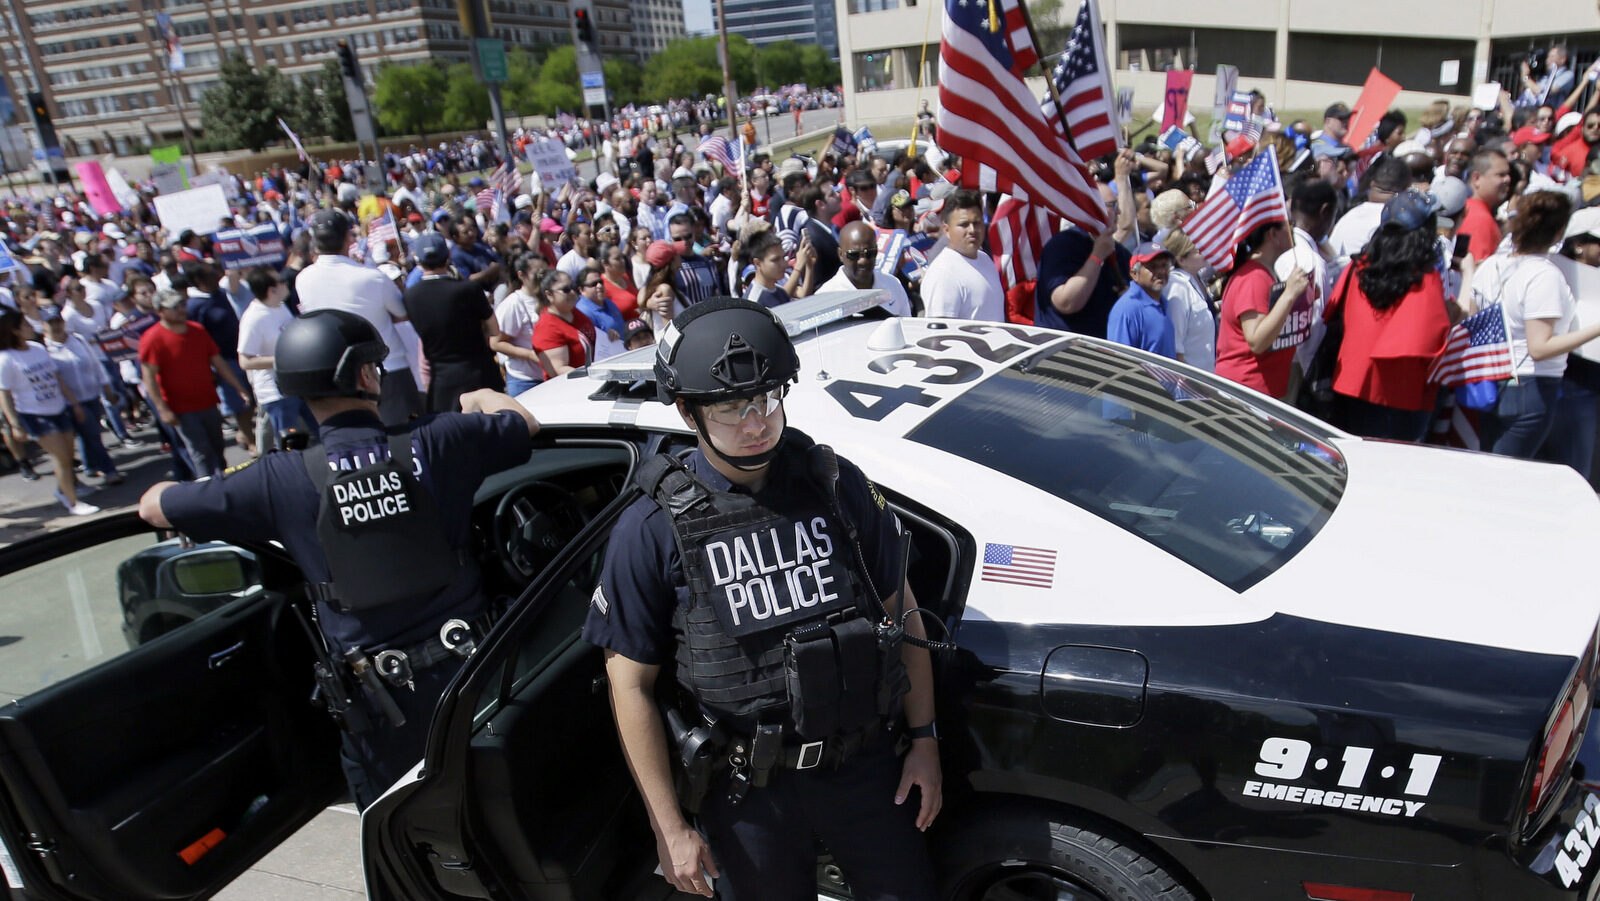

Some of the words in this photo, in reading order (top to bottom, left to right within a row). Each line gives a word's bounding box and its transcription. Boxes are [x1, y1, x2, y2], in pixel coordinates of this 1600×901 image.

[824, 325, 1065, 422] 4322
[333, 472, 402, 504] DALLAS
[340, 493, 410, 526] POLICE
[705, 516, 834, 586] DALLAS
[724, 558, 839, 626] POLICE
[1242, 780, 1426, 818] EMERGENCY
